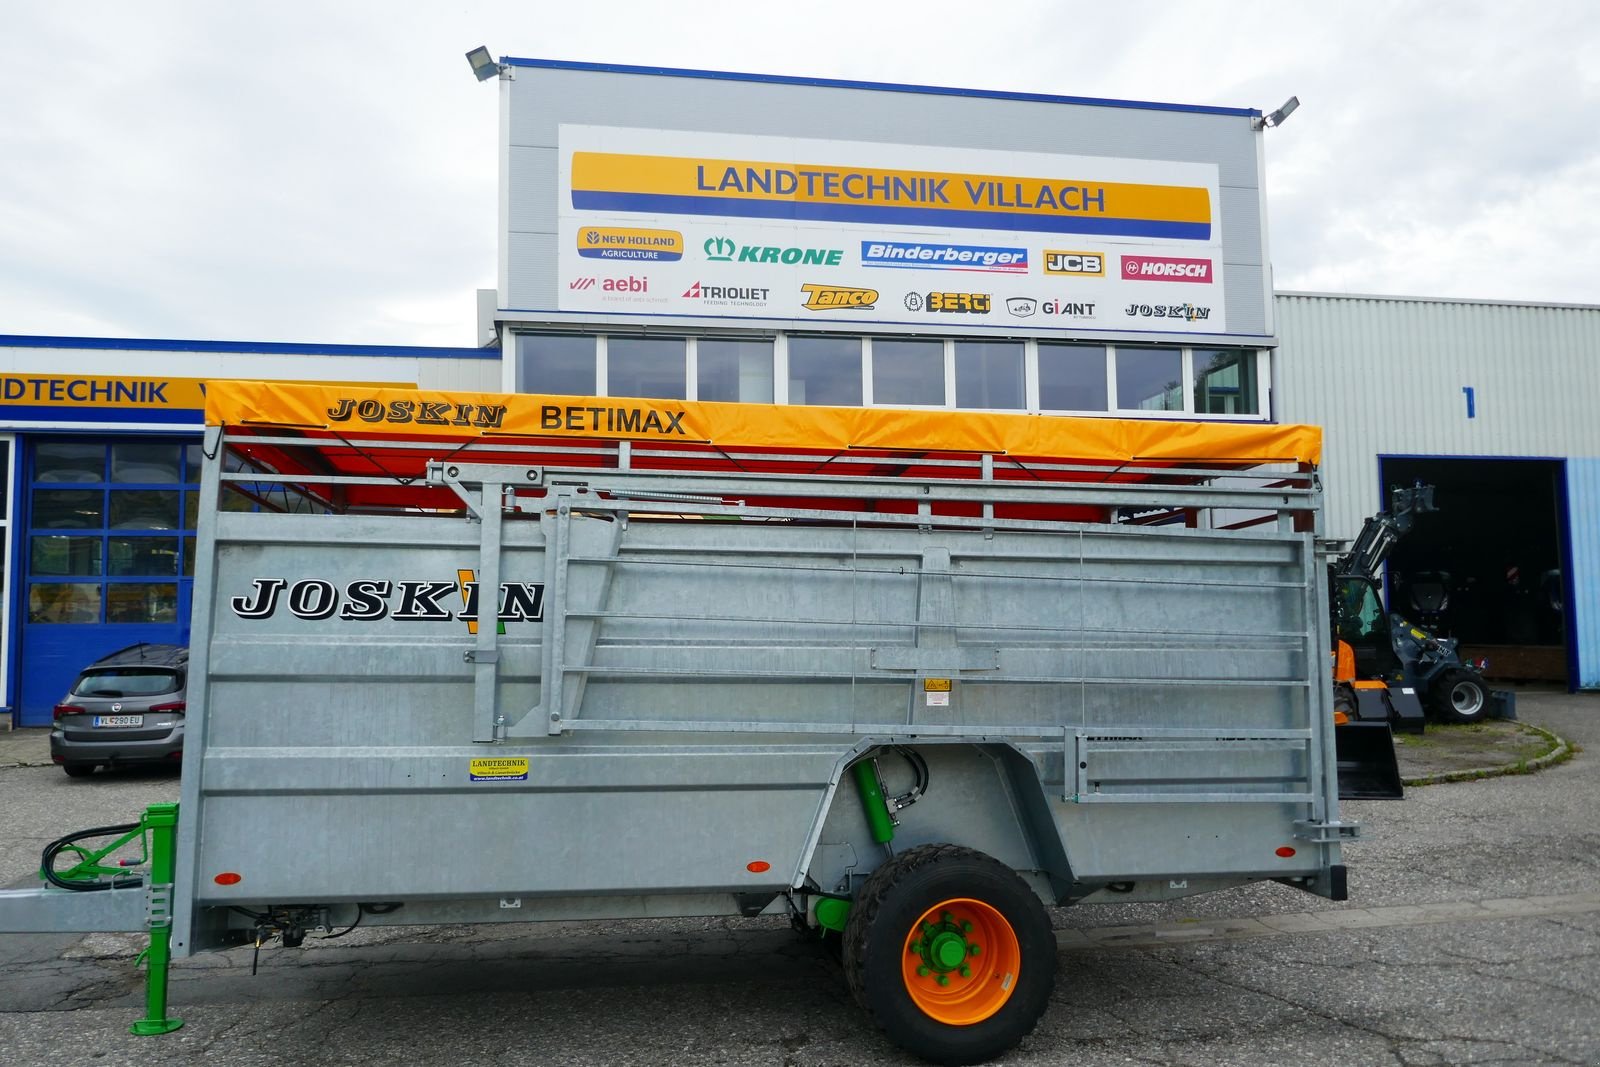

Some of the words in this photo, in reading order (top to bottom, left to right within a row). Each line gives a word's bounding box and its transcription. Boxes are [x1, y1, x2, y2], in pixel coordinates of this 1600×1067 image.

[697, 165, 951, 204] LANDTECHNIK
[963, 179, 1105, 212] VILLACH
[602, 235, 626, 244] NEW
[628, 236, 675, 246] HOLLAND
[601, 249, 658, 259] AGRICULTURE
[737, 246, 844, 266] KRONE
[867, 244, 1024, 266] Binderberger
[1047, 255, 1101, 273] JCB
[1140, 262, 1207, 278] HORSCH
[602, 275, 648, 293] aebi
[701, 286, 770, 300] TRIOLIET
[801, 284, 879, 310] Tanco
[1125, 303, 1211, 321] JOSKIN
[1462, 387, 1475, 418] 1
[327, 398, 508, 428] JOSKIN
[541, 405, 685, 435] BETIMAX
